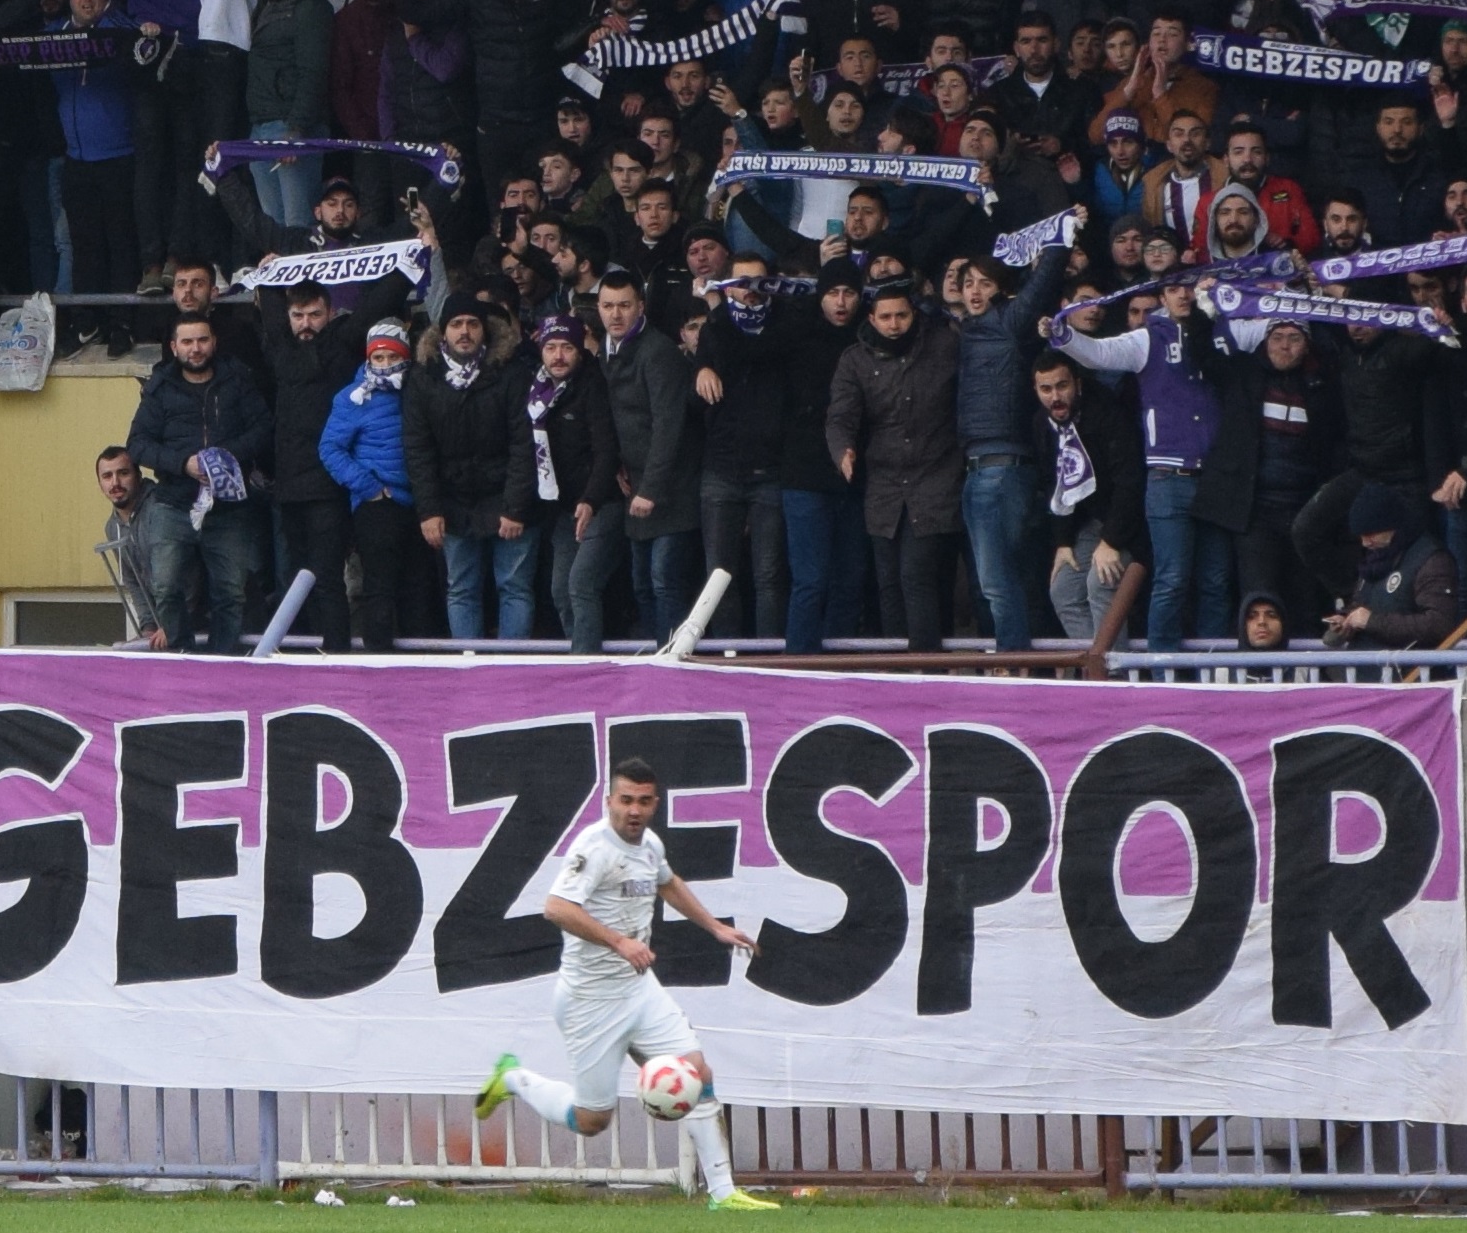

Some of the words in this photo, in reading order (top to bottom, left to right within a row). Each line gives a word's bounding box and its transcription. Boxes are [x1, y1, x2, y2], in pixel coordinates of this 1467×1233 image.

[38, 37, 115, 61] PURPLE
[1225, 45, 1403, 85] GEBZESPOR
[1257, 297, 1416, 327] GEBZESPOR
